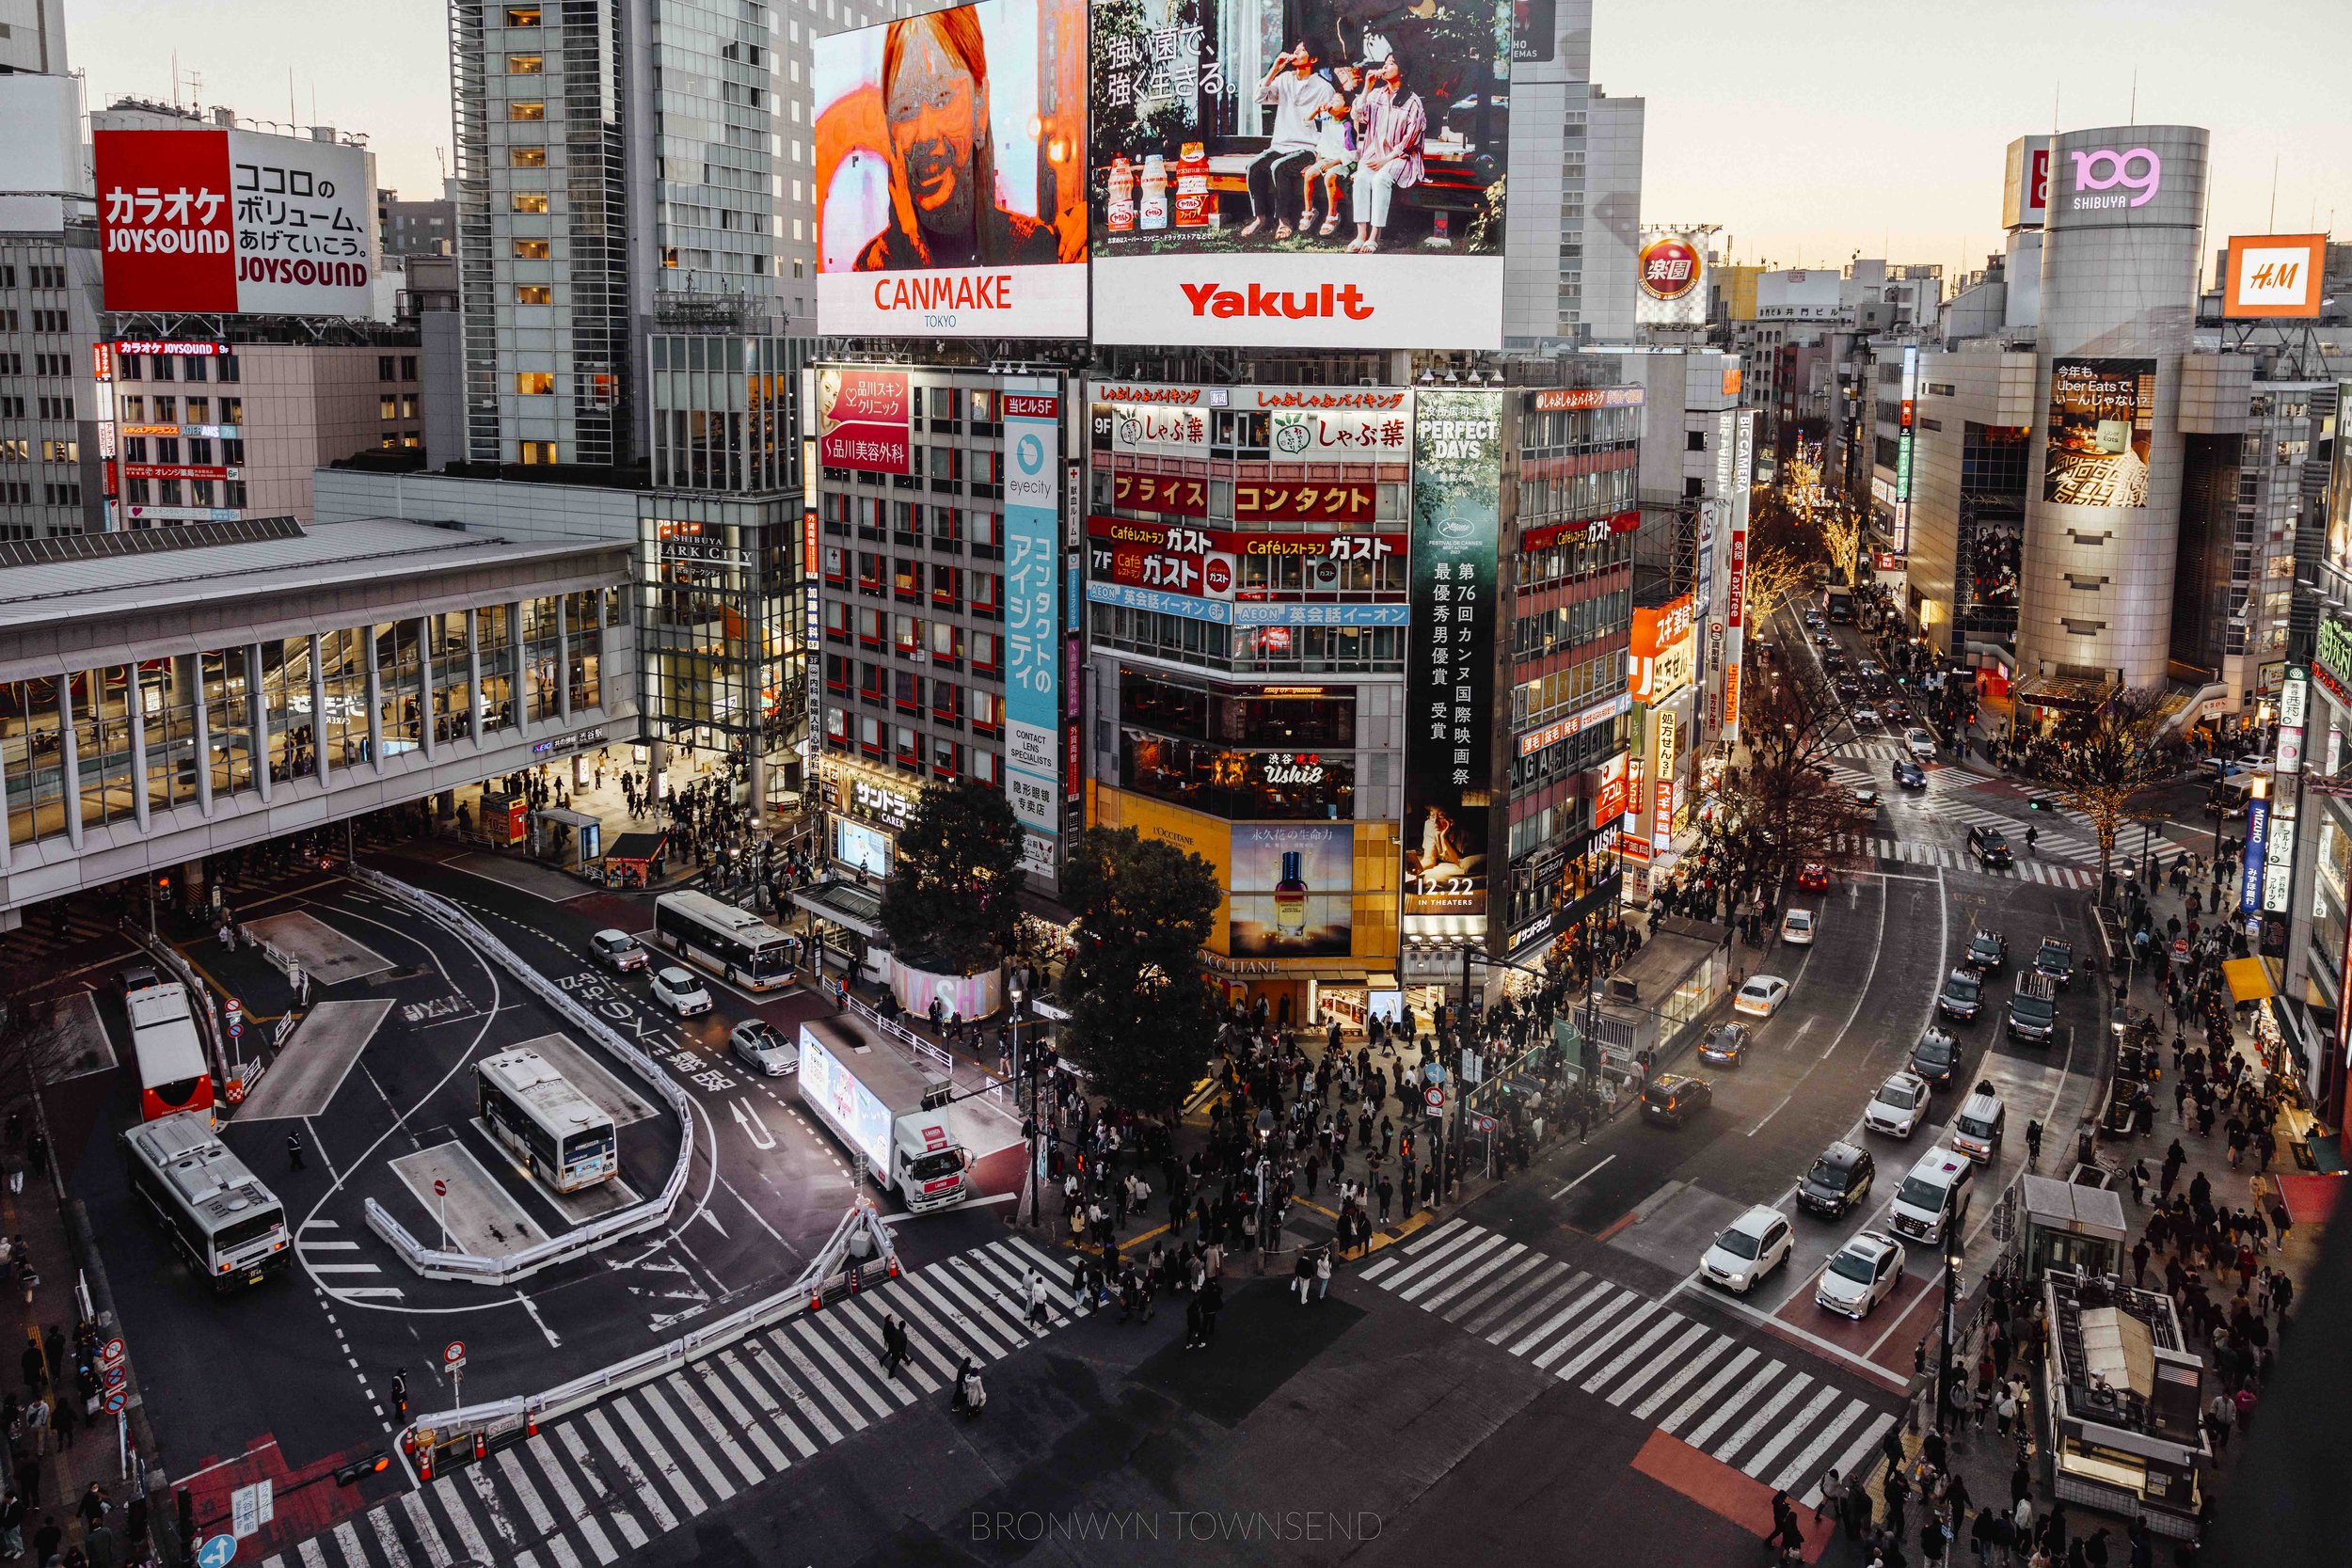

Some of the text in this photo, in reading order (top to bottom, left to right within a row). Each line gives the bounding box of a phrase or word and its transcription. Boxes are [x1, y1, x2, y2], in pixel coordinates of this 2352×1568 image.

[1107, 24, 1215, 71] 強い菌で、
[1107, 62, 1237, 108] 強く生きる。
[236, 164, 335, 198] ココロの
[2072, 148, 2160, 208] 109
[105, 186, 225, 226] カラオケ
[2074, 195, 2126, 210] SHIBUYA
[238, 197, 364, 232] ボリューム、
[107, 228, 230, 255] JOYSOUND
[239, 230, 367, 259] あげていこう。
[238, 256, 367, 288] JOYSOUND
[1646, 258, 1692, 280] 楽園
[2249, 262, 2299, 290] H&M
[874, 275, 1012, 310] CANMAKE
[1662, 277, 1698, 301] AMUSEMENT
[1180, 282, 1375, 321] Yakult
[1786, 308, 1838, 316] 井門ビル
[924, 315, 957, 327] TOKYO
[121, 342, 230, 355] カラオケ JOYSOUND 9F
[2058, 365, 2099, 378] 今年も、
[858, 381, 904, 397] 品川スキン
[1100, 385, 1200, 404] しゃぶしゃぶバイキング
[2058, 380, 2086, 392] Uber
[858, 399, 899, 416] クリニック
[1009, 398, 1052, 414] 当ビル5F
[1257, 390, 1406, 409] しゃぶしゃぶバイキング
[182, 426, 219, 438] ADERANS
[1094, 418, 1111, 435] 9F
[1146, 415, 1203, 444] しゃぶ葉
[1319, 419, 1405, 448] しゃぶ葉
[1420, 420, 1498, 439] PERFECT
[833, 439, 904, 464] 品川美容外科
[1436, 440, 1481, 458] DAYS
[1738, 416, 1751, 494] BIC CAMERA
[154, 468, 194, 477] オレンジ薬局
[1009, 480, 1052, 499] eyecity
[1116, 476, 1206, 507] プライス
[1237, 487, 1371, 514] コンタクト
[674, 534, 723, 546] SHIBUYA
[1167, 528, 1213, 555] ガスト
[1588, 520, 1611, 543] ガスト
[1093, 550, 1112, 569] 7F
[1329, 536, 1392, 561] ガスト
[1734, 542, 1743, 561] 免税
[1143, 554, 1199, 589] ガスト
[1210, 573, 1229, 583] ガスト
[1090, 585, 1115, 599] AEON
[1124, 589, 1204, 615] 英会話イーオン
[1010, 534, 1032, 689] アイシティ
[1035, 538, 1052, 693] コンタクトの
[1241, 607, 1406, 623] AEON 英会話イーオン
[1656, 604, 1692, 647] スギ薬局
[1430, 562, 1451, 740] 最優秀男優賞 受賞
[1618, 695, 1631, 712] 4F
[579, 728, 603, 742] 渋谷駅
[1016, 729, 1046, 745] CONTACT
[1010, 748, 1052, 768] SPECIALISTS
[1023, 741, 1040, 753] LENS
[1268, 753, 1293, 765] 渋谷
[1263, 765, 1324, 784] Ushi8
[1012, 780, 1051, 803] 隐形眼镜
[1602, 780, 1622, 806] アコム
[1018, 798, 1045, 816] 专卖店
[1251, 829, 1333, 841] 永久花の生命力
[2252, 808, 2265, 844] MIZUHO
[1588, 824, 1617, 860] LUSH
[1417, 878, 1474, 895] 12.22
